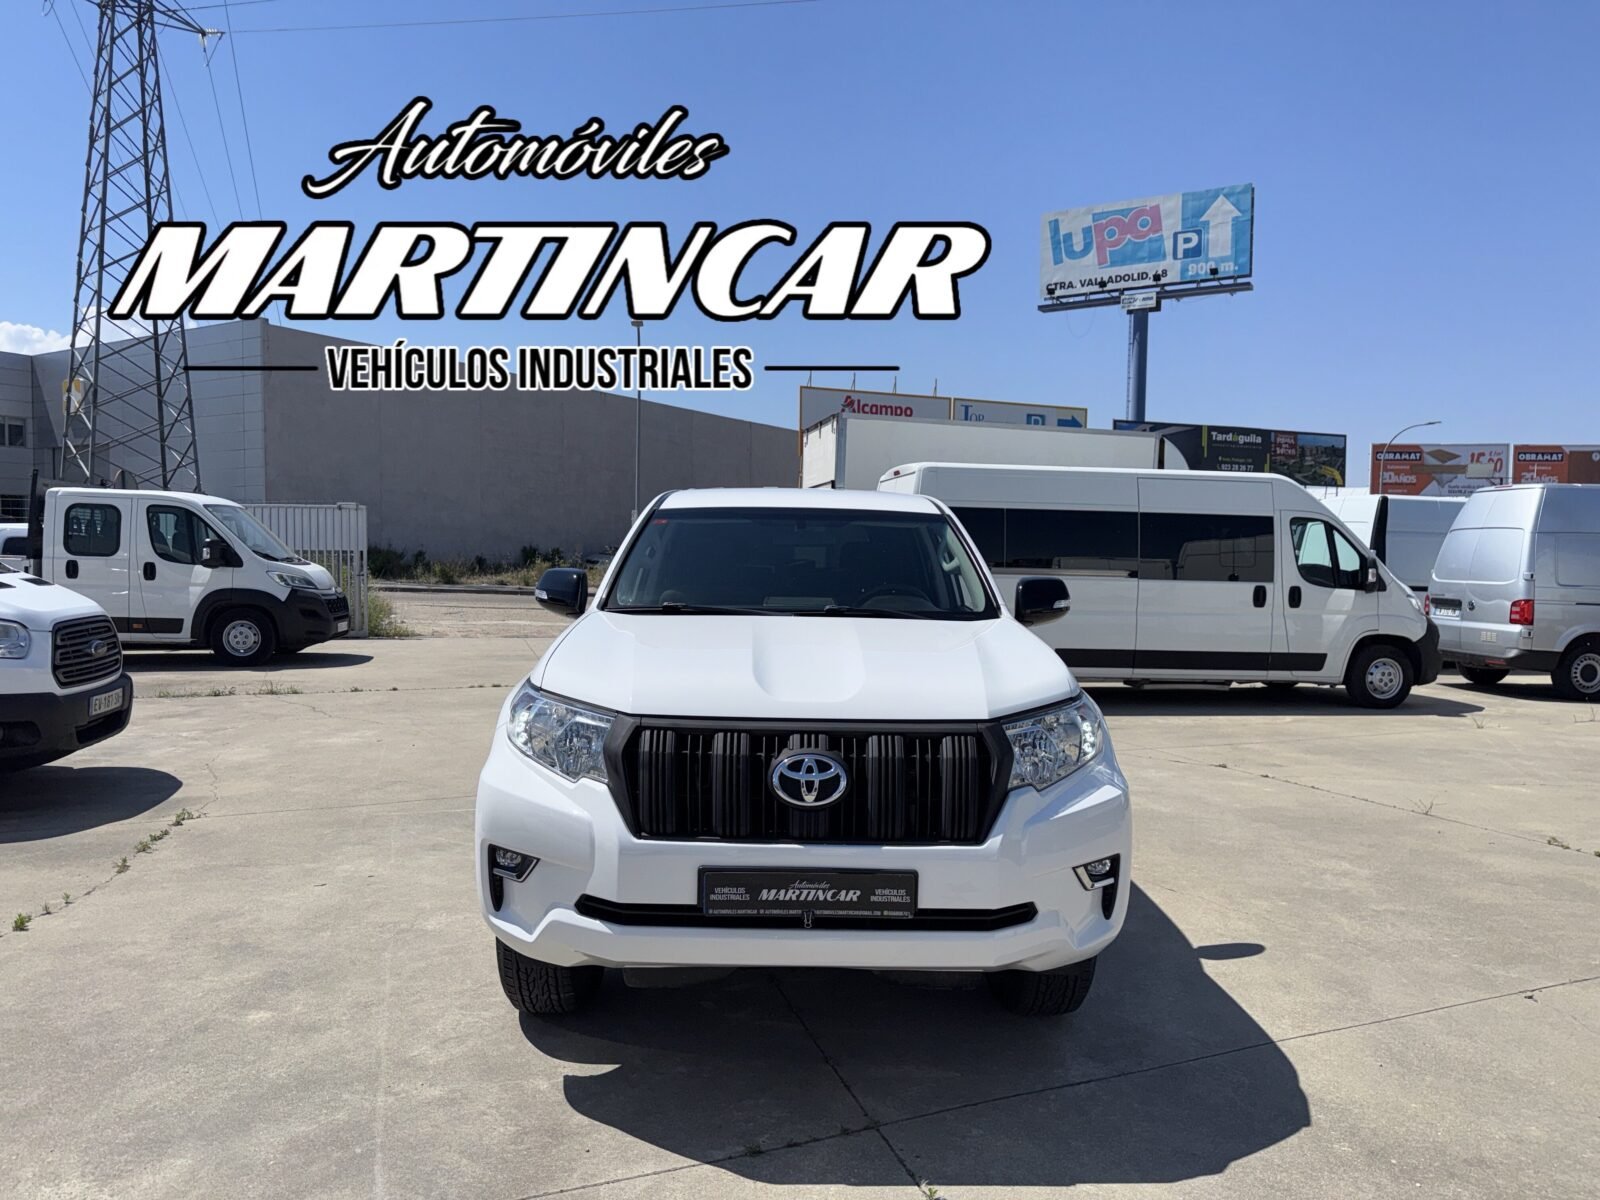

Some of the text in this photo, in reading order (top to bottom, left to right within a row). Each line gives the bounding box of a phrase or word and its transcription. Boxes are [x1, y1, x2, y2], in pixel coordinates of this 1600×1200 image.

[1048, 204, 1163, 266] lupa
[1176, 232, 1200, 258] P
[1211, 431, 1261, 443] Tardáguila
[1518, 453, 1563, 461] OBRAMAT
[758, 889, 861, 902] MARTINCAR
[870, 895, 911, 903] INDUSTRIALES
